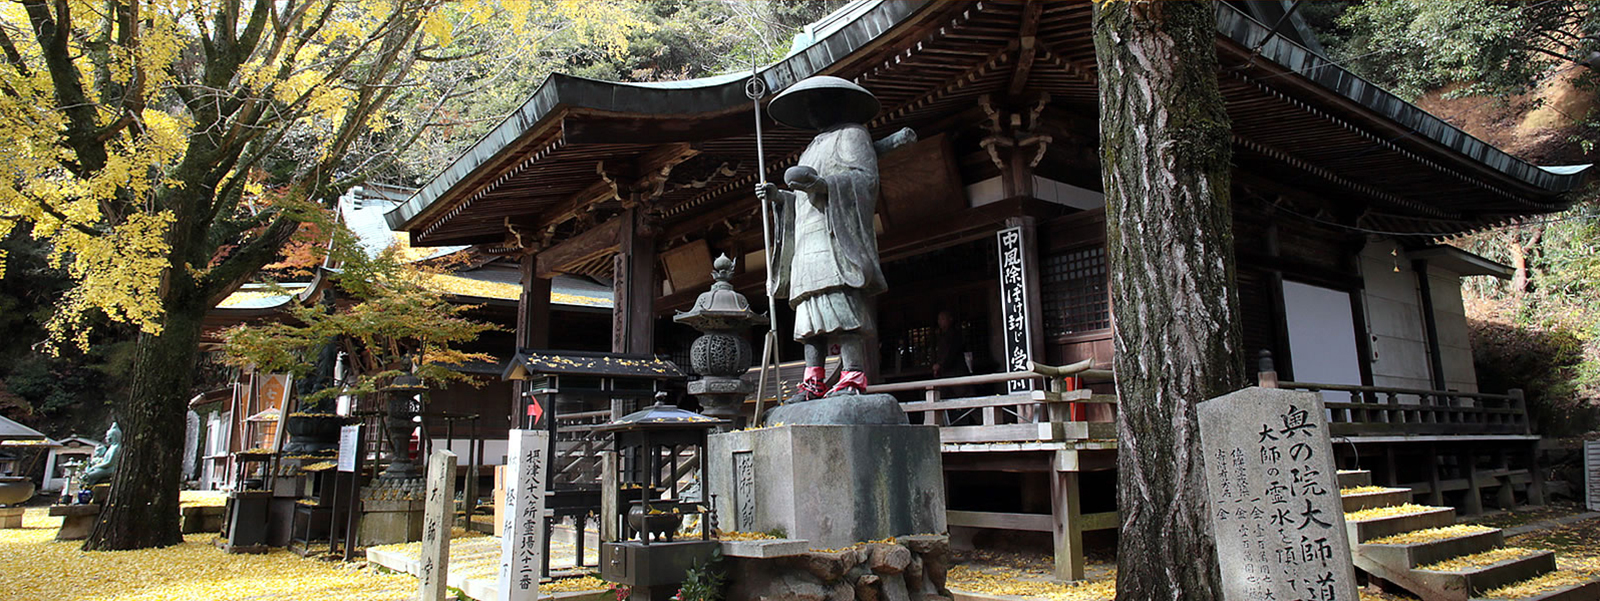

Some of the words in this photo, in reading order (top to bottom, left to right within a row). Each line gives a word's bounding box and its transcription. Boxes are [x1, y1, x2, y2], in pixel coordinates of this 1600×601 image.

[1279, 404, 1336, 601] 奥の院大師道
